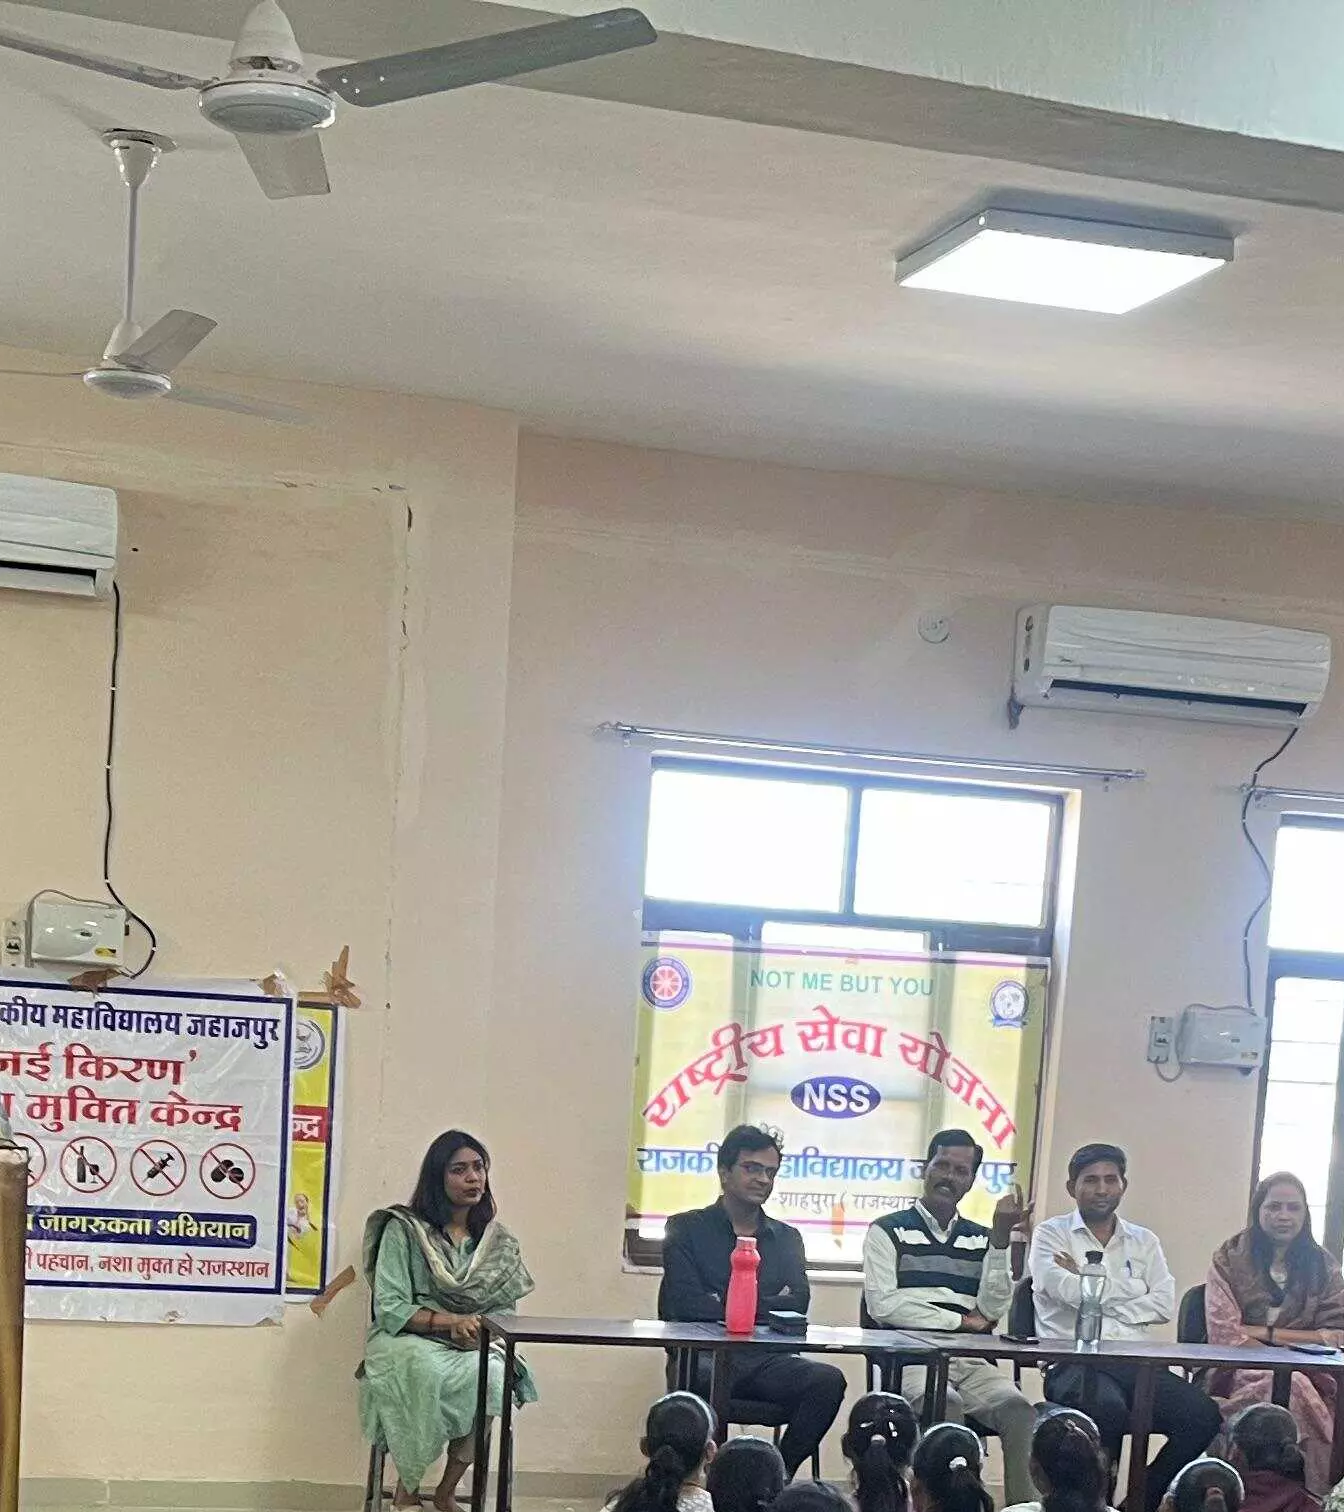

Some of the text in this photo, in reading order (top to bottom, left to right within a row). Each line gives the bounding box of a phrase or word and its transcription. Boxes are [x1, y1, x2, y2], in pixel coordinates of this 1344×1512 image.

[749, 969, 935, 997] NOT ME BUT YOU
[52, 1001, 182, 1037] महाविद्यालय
[187, 1013, 282, 1050] जहाजपुर
[642, 1005, 1018, 1149] राष्ट्रीय सेवा योजना
[26, 1085, 141, 1132] मुक्ति
[150, 1091, 243, 1132] केन्द्र
[802, 1083, 872, 1114] NSS
[155, 1213, 251, 1240] अभियान
[98, 1255, 133, 1273] नशा
[137, 1257, 174, 1281] मुक्त
[176, 1253, 193, 1276] हो
[197, 1259, 270, 1279] राजस्थान
